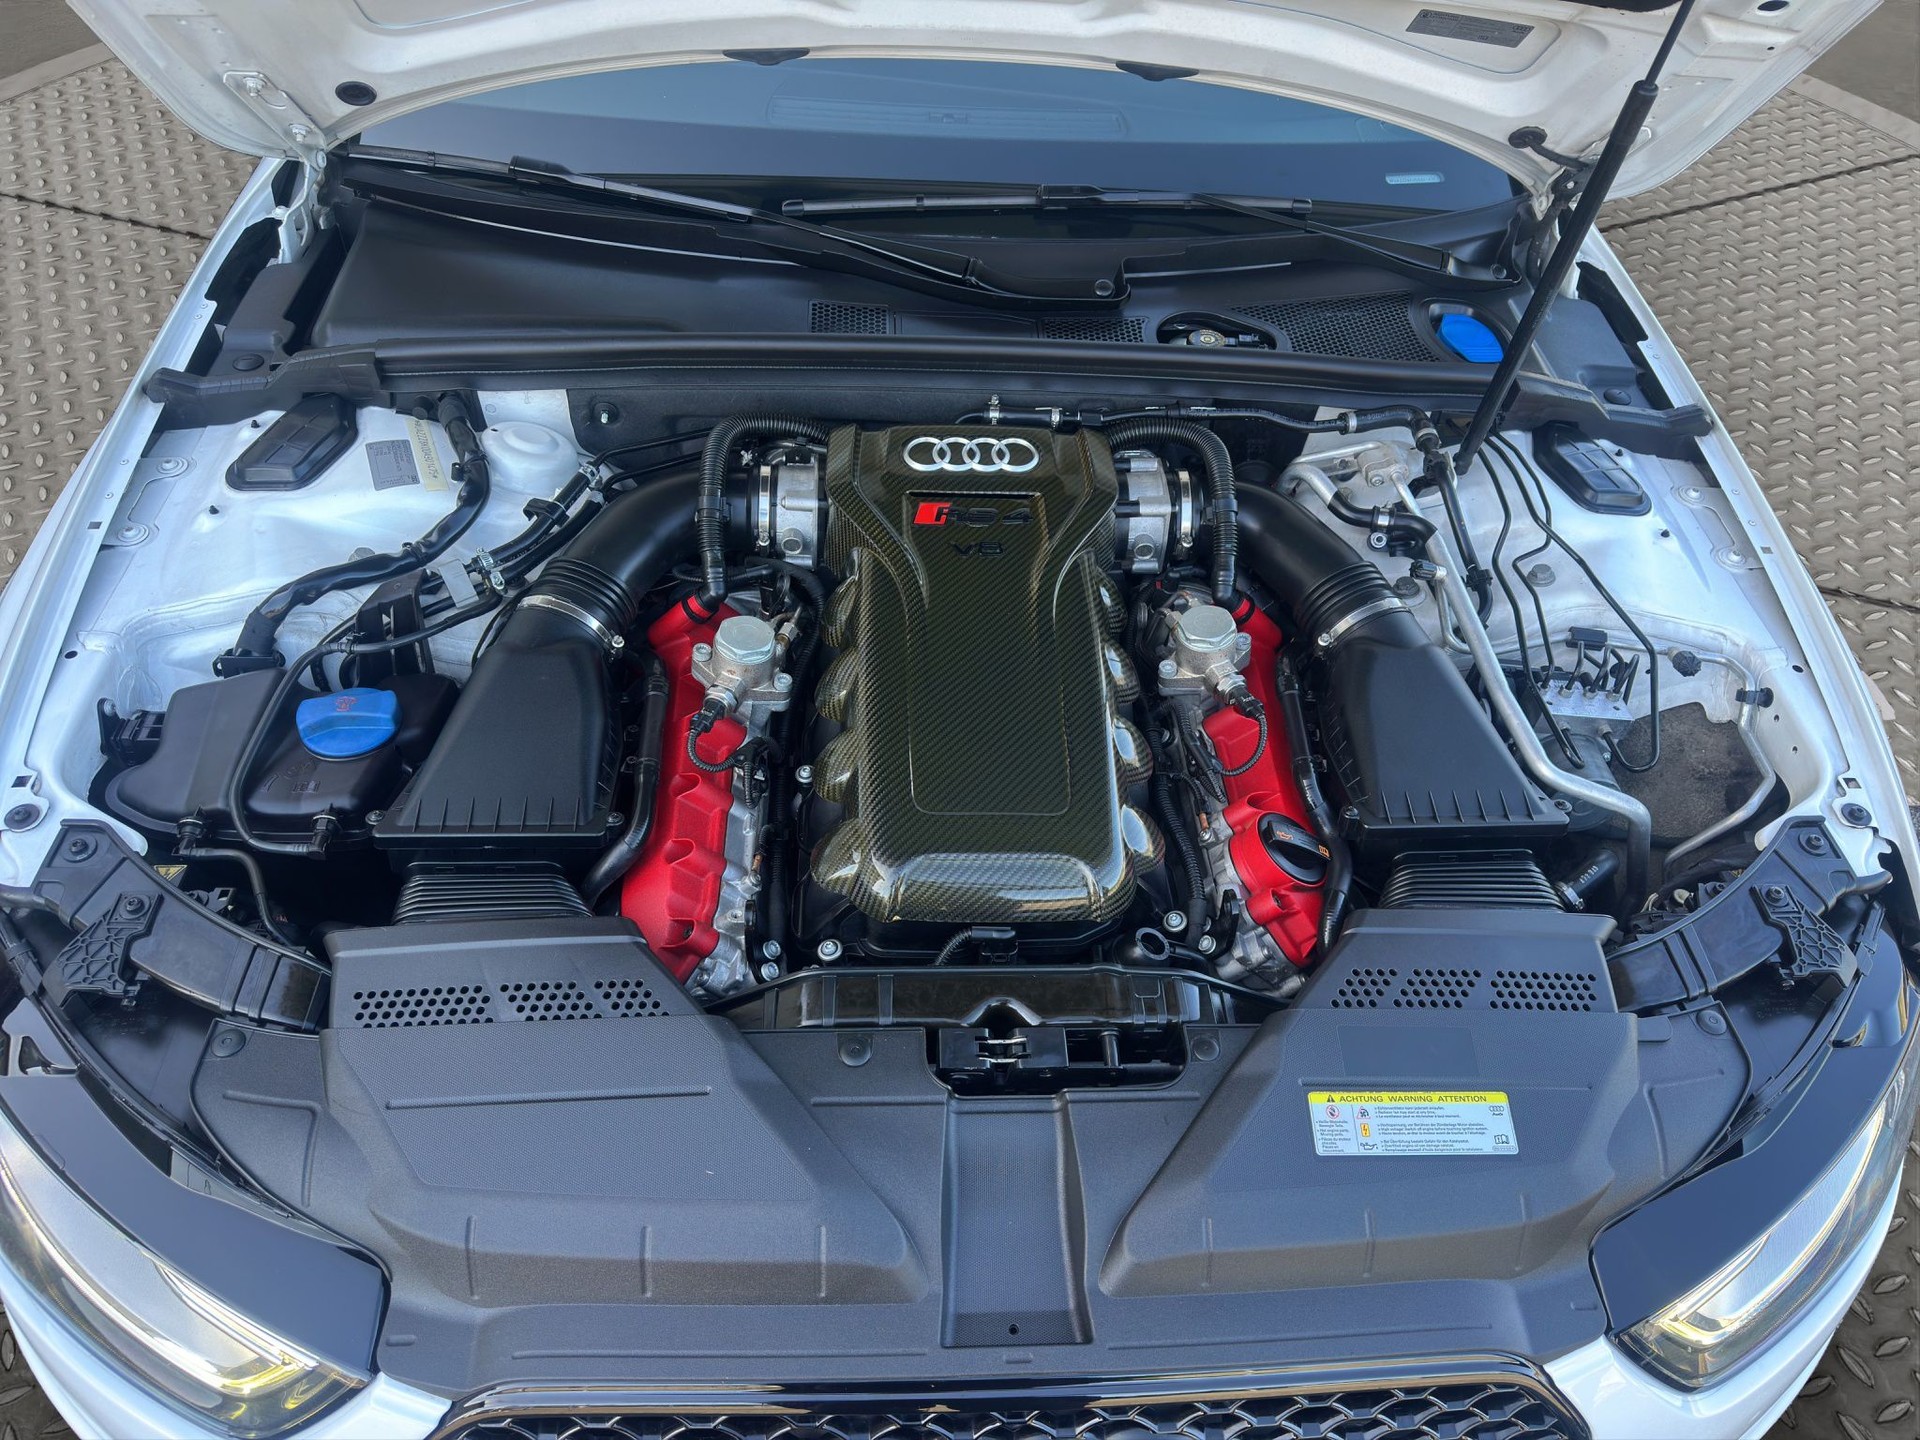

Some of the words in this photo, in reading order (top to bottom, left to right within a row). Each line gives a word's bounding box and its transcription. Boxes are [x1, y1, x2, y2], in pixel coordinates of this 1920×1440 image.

[954, 541, 1004, 558] V8
[1339, 1095, 1384, 1103] ACHTUNG
[1388, 1095, 1433, 1103] WARNING
[1438, 1095, 1487, 1103] ATTENTION
